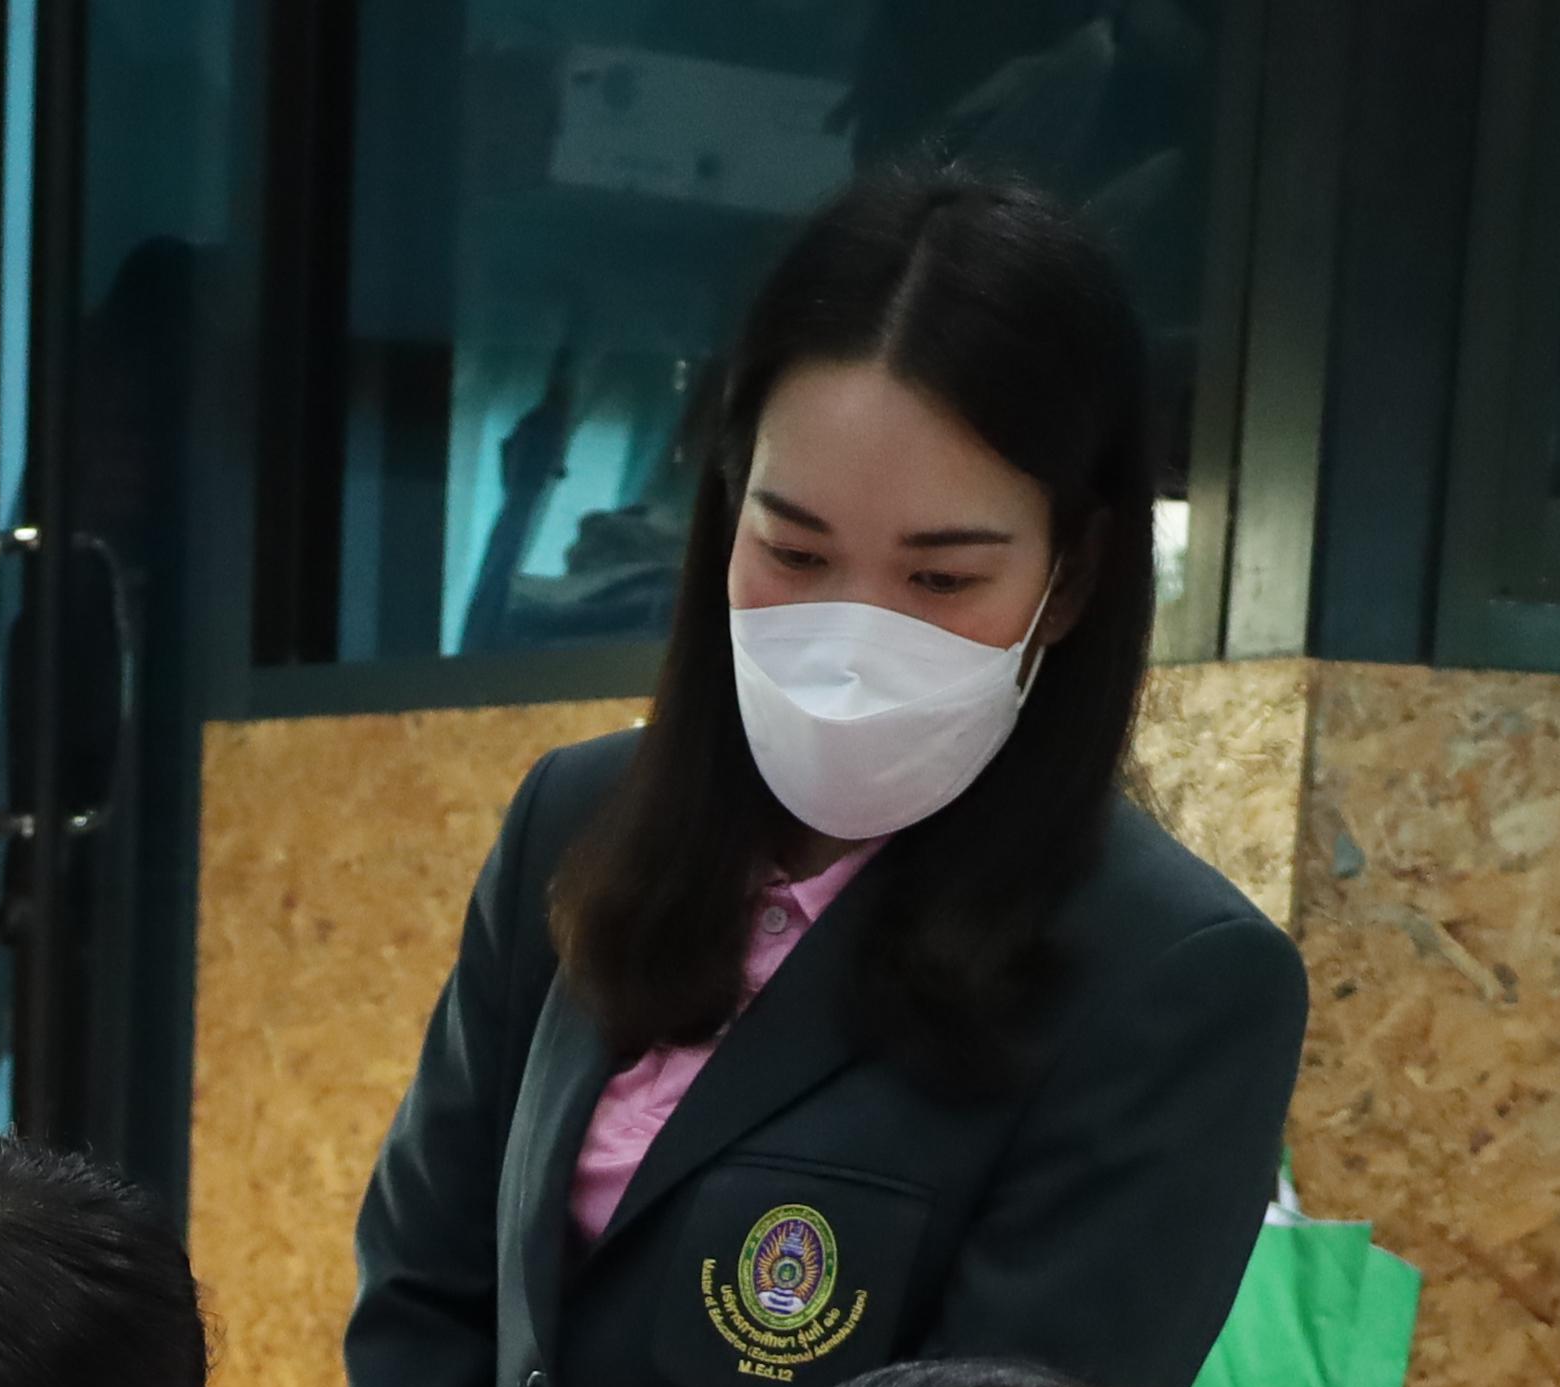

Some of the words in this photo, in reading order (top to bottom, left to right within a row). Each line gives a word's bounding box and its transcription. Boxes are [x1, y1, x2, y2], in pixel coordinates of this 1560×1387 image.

[701, 1258, 716, 1295] Master
[708, 1307, 747, 1352] Education
[720, 1284, 795, 1347] บริหารการศึกษา
[737, 1359, 794, 1382] M.Ed.12
